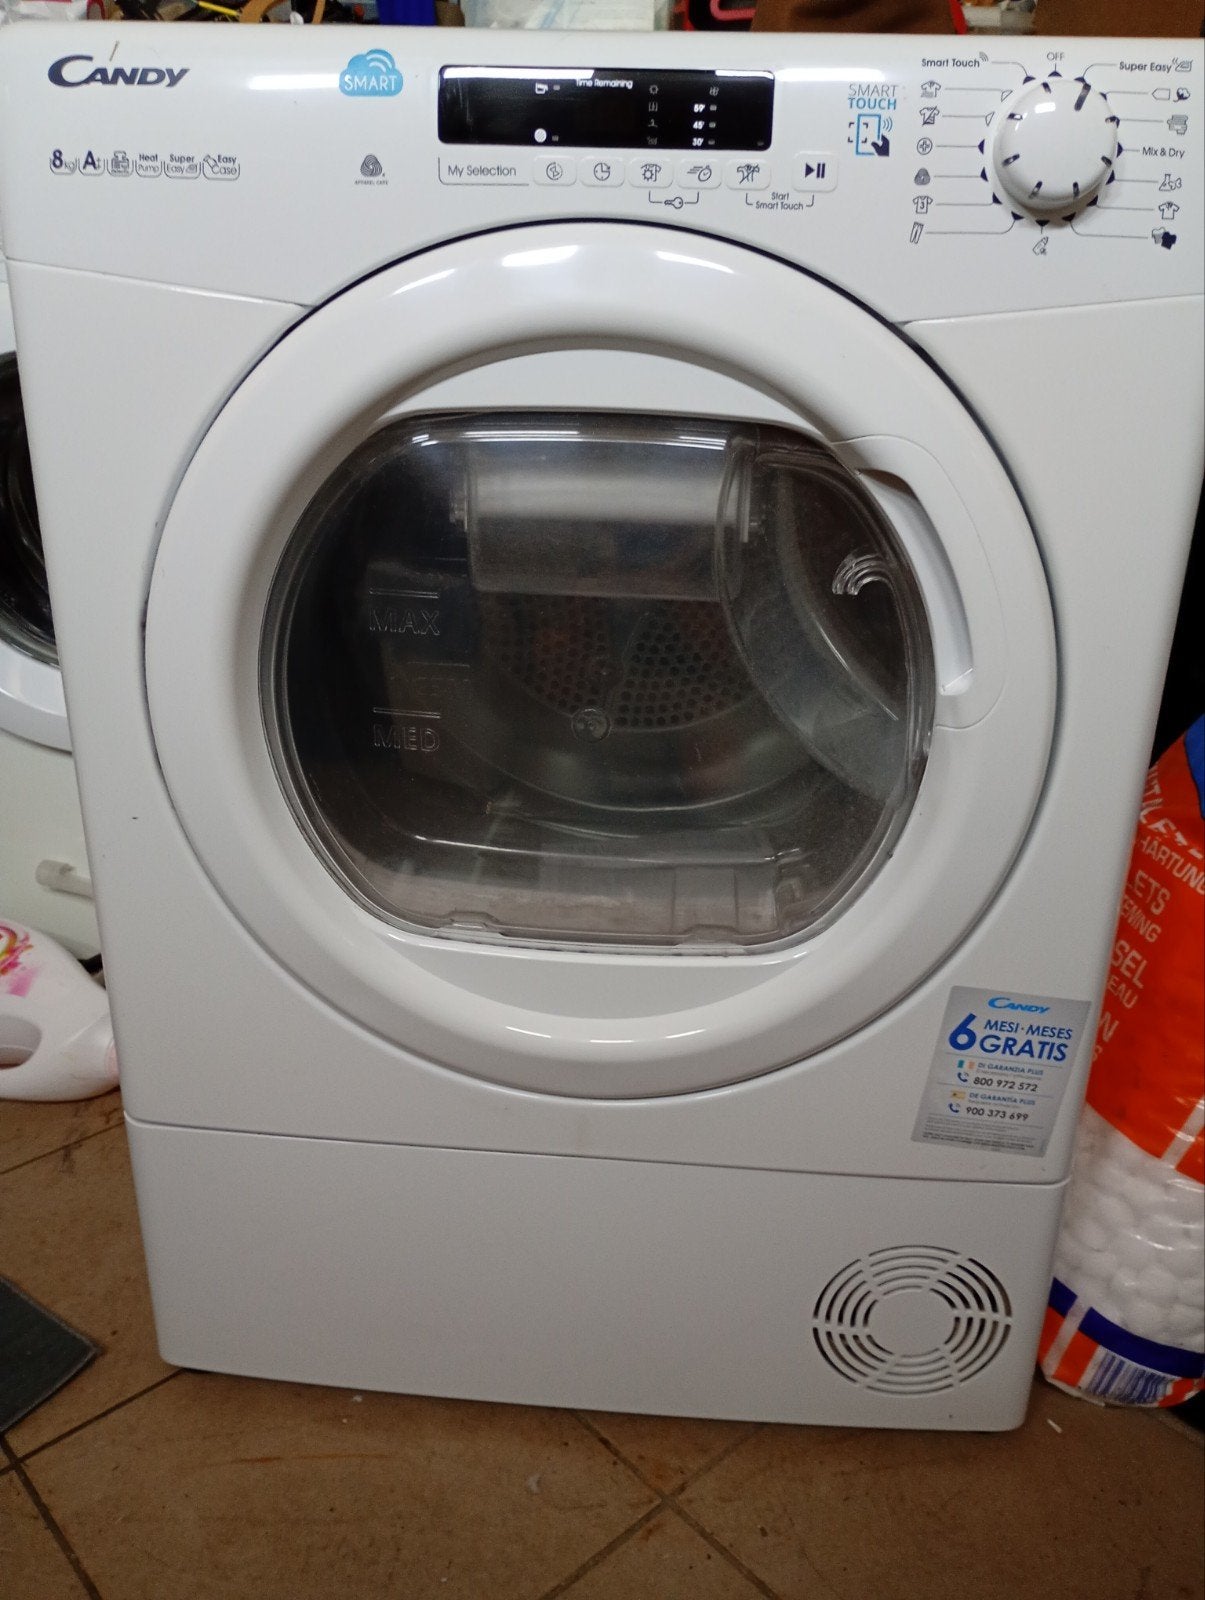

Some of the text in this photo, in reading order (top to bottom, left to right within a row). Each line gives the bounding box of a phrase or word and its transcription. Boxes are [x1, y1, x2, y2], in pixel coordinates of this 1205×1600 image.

[921, 58, 980, 68] Smart Touch
[1046, 51, 1064, 62] OFF
[47, 54, 191, 88] CANDY
[1119, 61, 1172, 74] Super Easy
[343, 75, 398, 92] SMART
[576, 79, 634, 90] Time Remaining
[848, 83, 898, 97] SMART
[848, 98, 897, 110] TOUCH
[139, 154, 158, 163] Heat
[169, 154, 195, 164] Super
[217, 154, 237, 165] Easy
[1142, 147, 1185, 160] Mix & Dry
[167, 164, 185, 175] Easy
[447, 164, 517, 178] My Selection
[771, 191, 790, 201] Start
[755, 200, 804, 211] Smart Touch
[369, 607, 440, 636] MAX
[373, 724, 440, 752] MED
[988, 997, 1050, 1014] CANDY
[948, 1013, 977, 1051] 6
[984, 1019, 1019, 1034] MESI
[1026, 1025, 1073, 1040] MESES
[979, 1034, 1069, 1062] GRATIS
[973, 1076, 1038, 1093] 800 972 572
[966, 1106, 1029, 1122] 900 373 699
